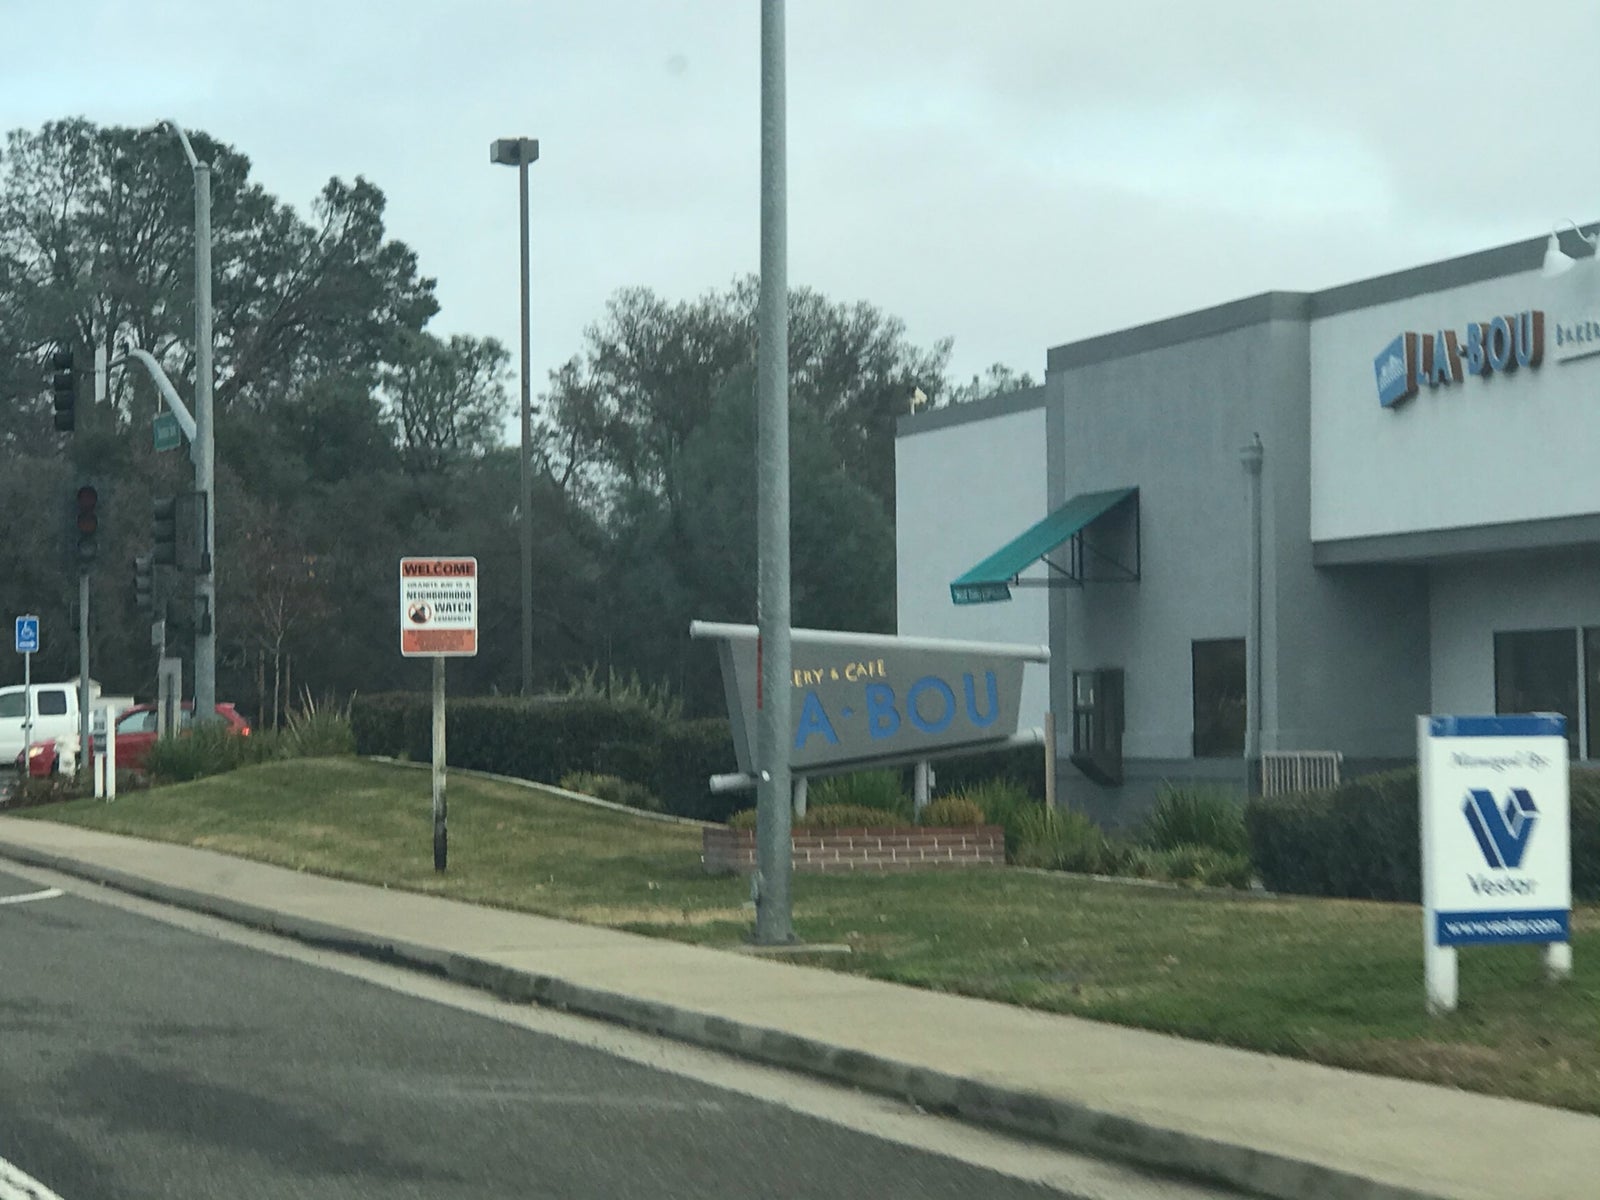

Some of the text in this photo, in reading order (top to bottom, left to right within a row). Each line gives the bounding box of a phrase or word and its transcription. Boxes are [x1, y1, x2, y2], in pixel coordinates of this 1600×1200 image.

[405, 564, 471, 574] WELCOME
[406, 591, 472, 600] NEIGHBORHOOD
[434, 602, 472, 613] WATCH
